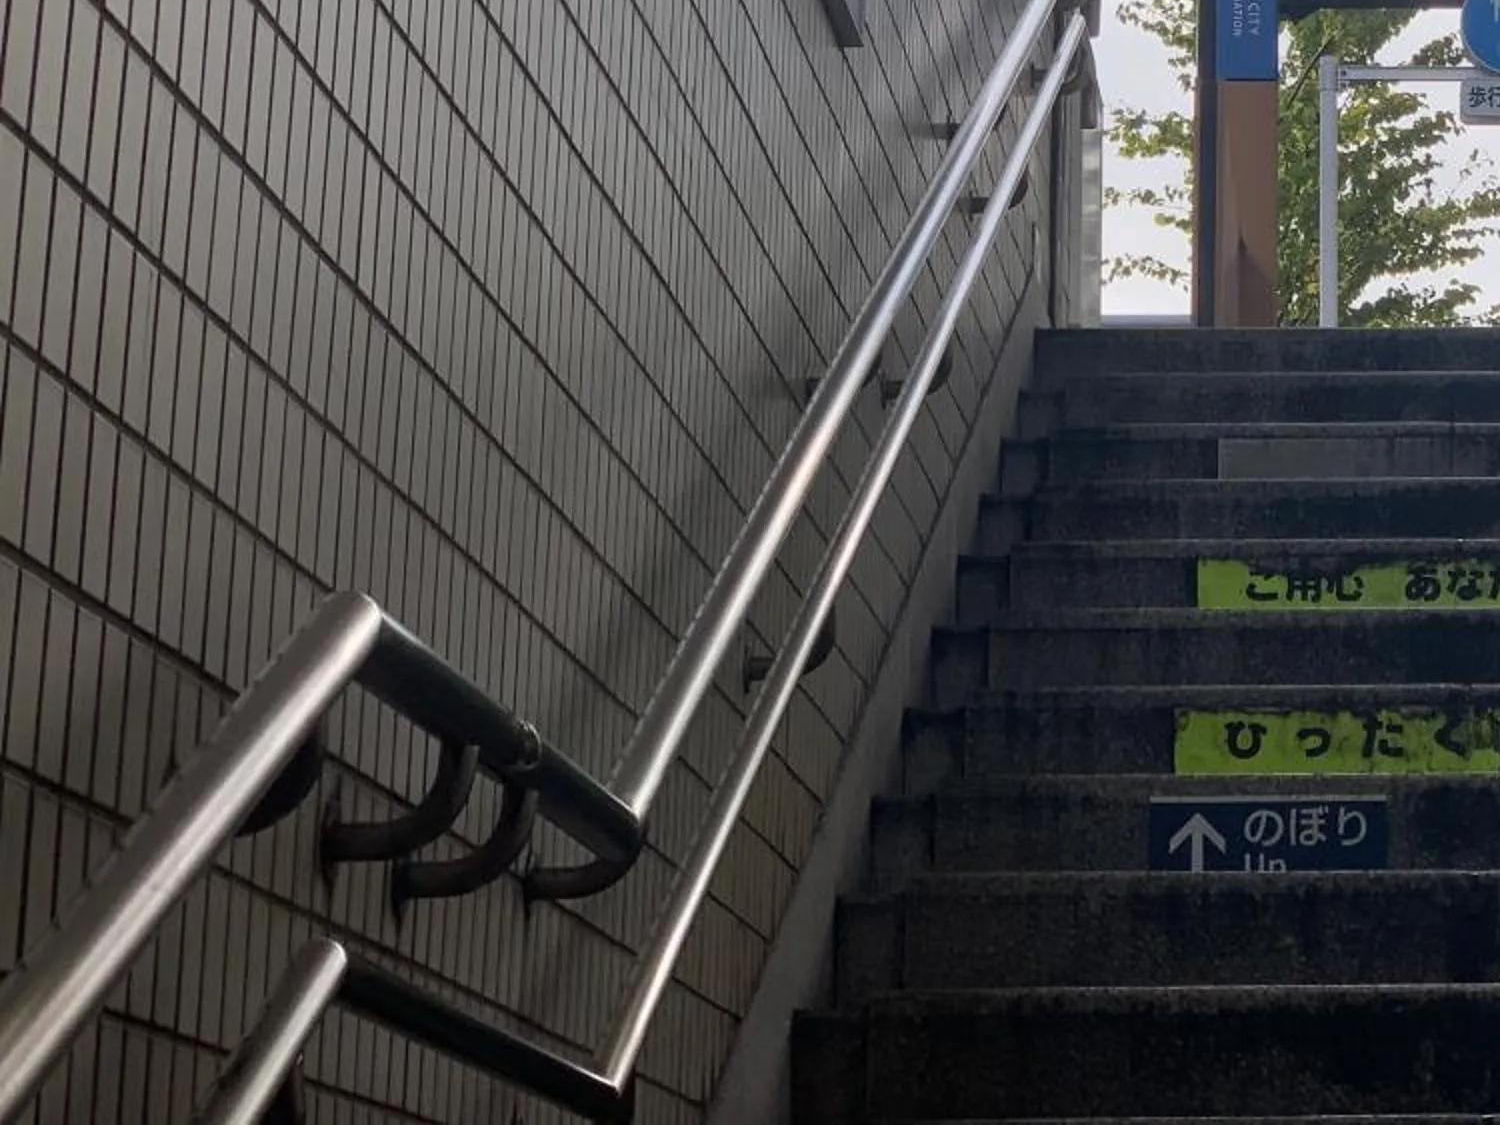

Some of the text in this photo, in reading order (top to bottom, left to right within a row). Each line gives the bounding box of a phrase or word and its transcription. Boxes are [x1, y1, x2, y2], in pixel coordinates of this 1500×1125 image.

[1247, 1, 1261, 37] CITY
[1243, 805, 1368, 847] のぼり
